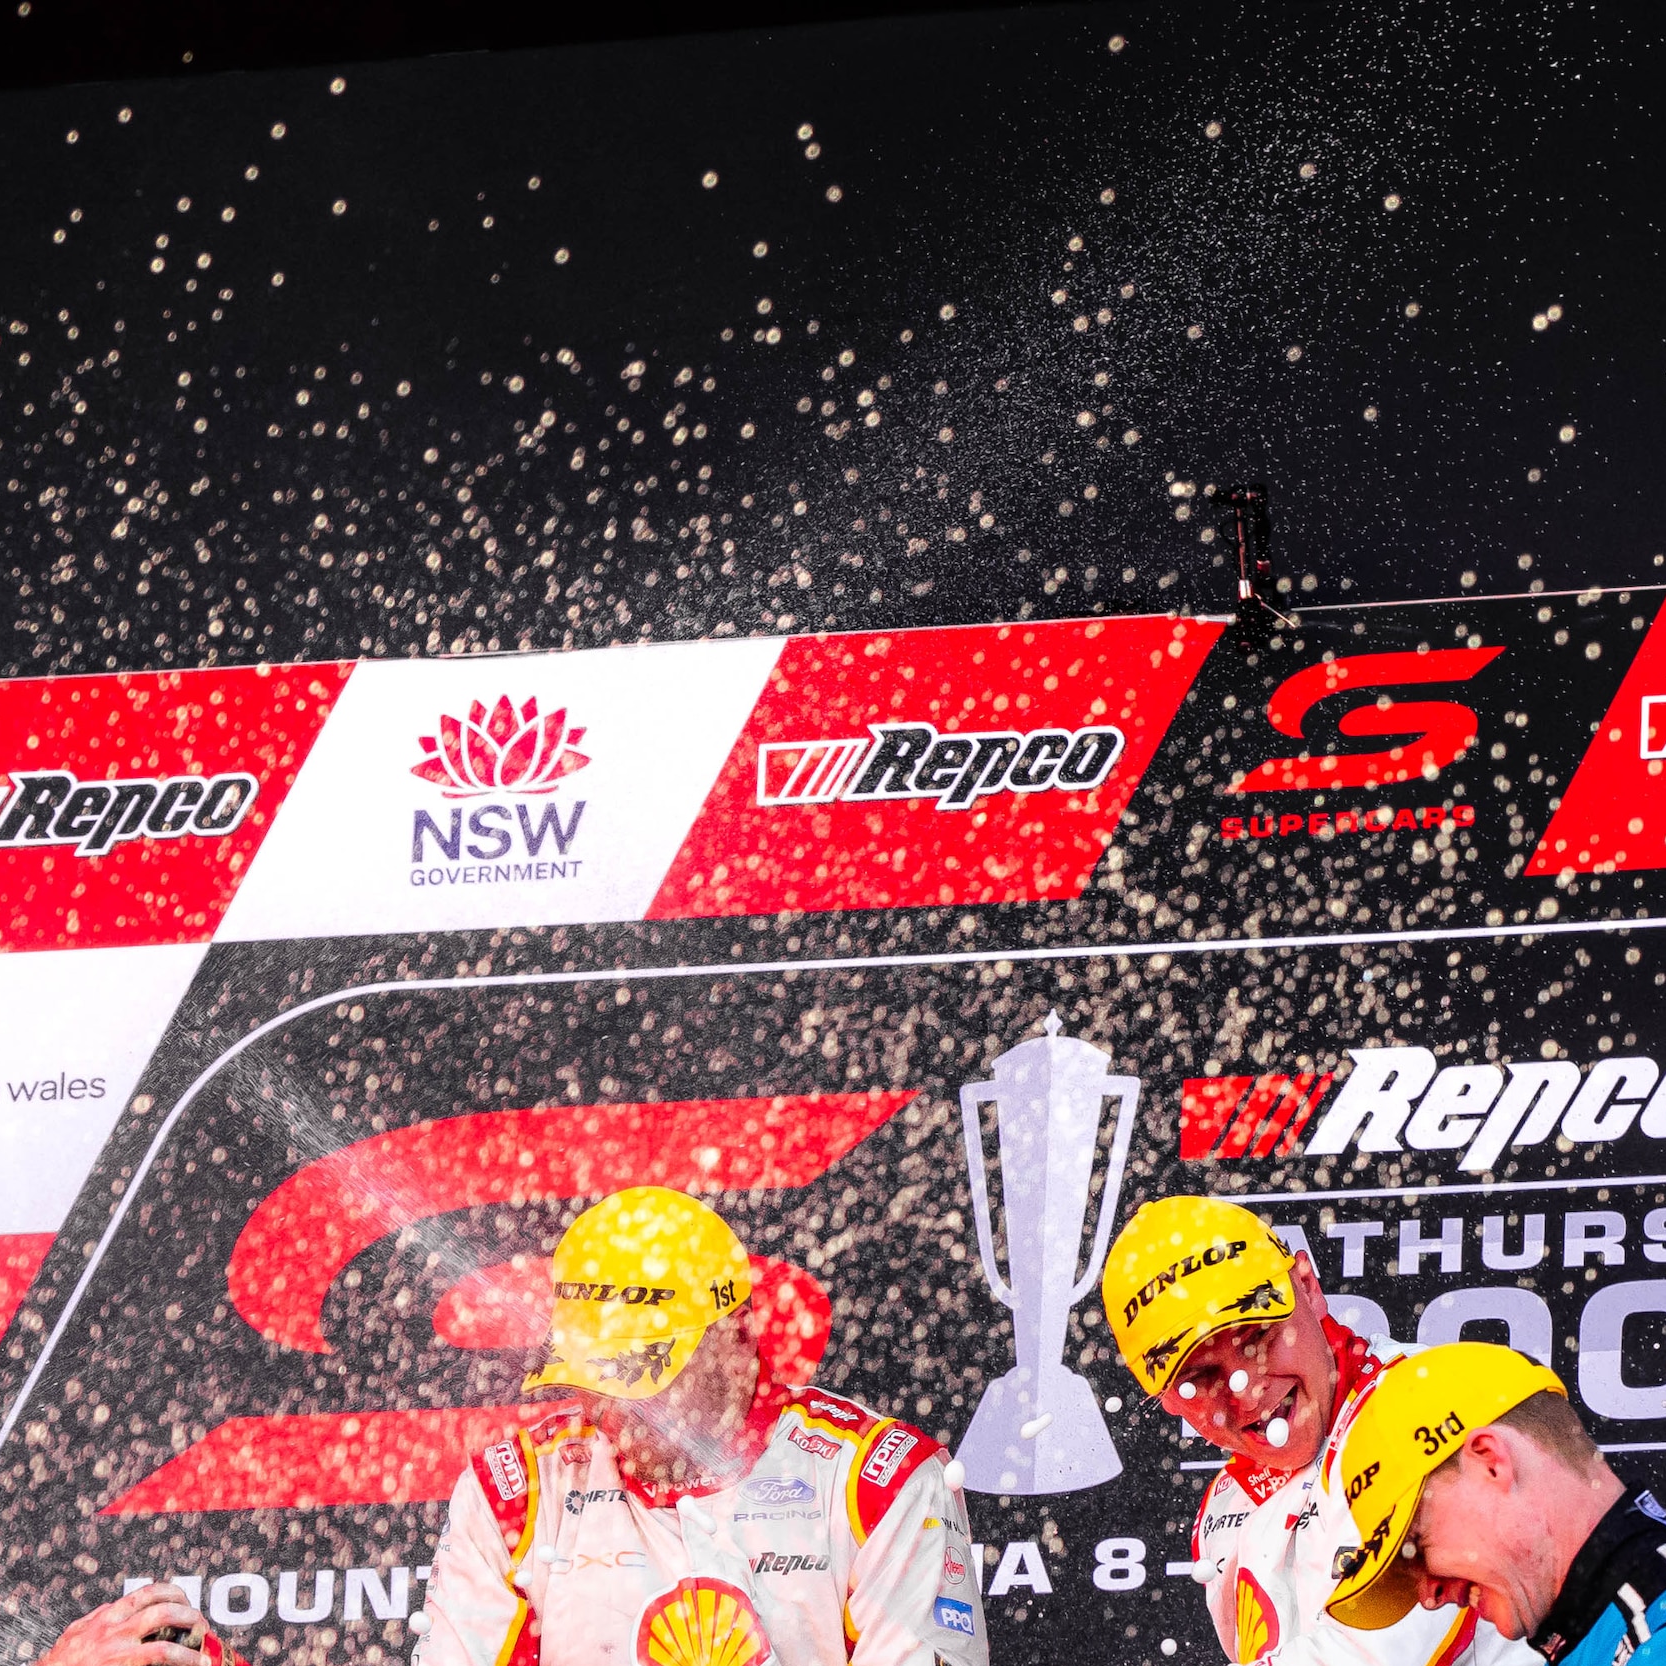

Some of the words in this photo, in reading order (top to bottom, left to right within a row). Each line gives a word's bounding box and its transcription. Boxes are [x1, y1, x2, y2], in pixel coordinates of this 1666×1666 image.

[843, 721, 1126, 811] Repco
[410, 800, 587, 862] NSW
[1220, 804, 1476, 839] SUPERCARS
[408, 861, 584, 888] GOVERNMENT
[7, 1071, 106, 1103] wales
[710, 1279, 737, 1311] 1st
[1123, 1240, 1247, 1328] DUNLOP
[1414, 1411, 1466, 1457] 3rd
[496, 1442, 526, 1493] rpm
[864, 1429, 907, 1480] rpm
[755, 1482, 804, 1501] Ford
[1248, 1467, 1273, 1488] Shell
[1344, 1460, 1381, 1510] LOP
[733, 1510, 822, 1523] RACING
[753, 1551, 831, 1576] Repco
[940, 1606, 974, 1634] PPQ
